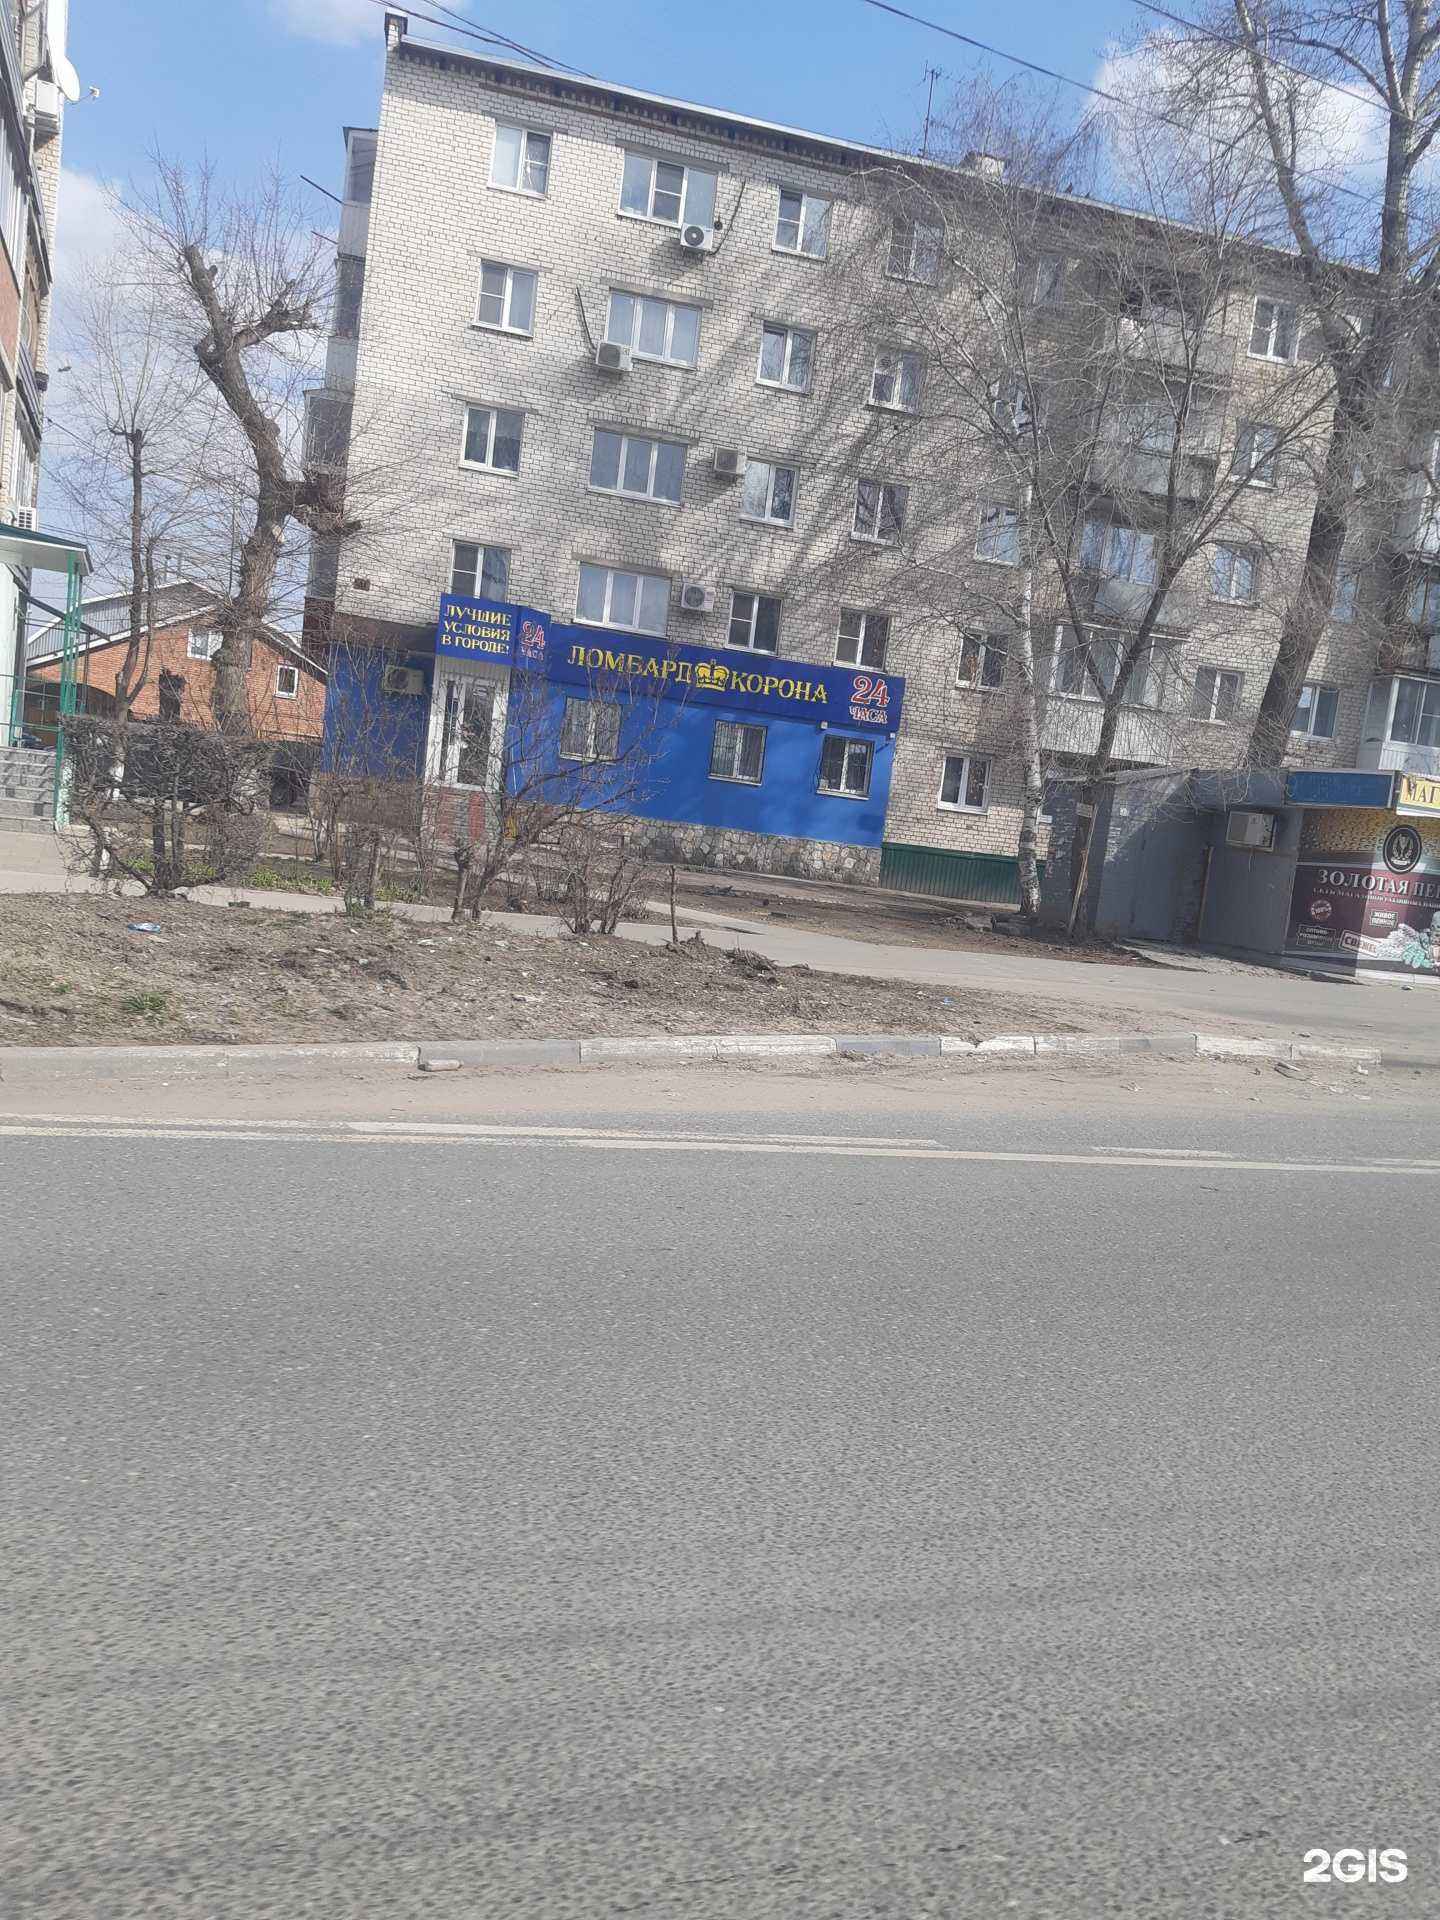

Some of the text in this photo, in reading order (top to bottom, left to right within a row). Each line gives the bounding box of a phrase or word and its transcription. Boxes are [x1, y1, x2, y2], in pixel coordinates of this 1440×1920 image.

[444, 604, 512, 626] ЛУЧШИЕ
[444, 620, 510, 641] УСЛОВИЯ
[522, 620, 545, 649] 24
[441, 634, 512, 656] В ГОРОДЕ!
[567, 645, 828, 704] ЛОМБАРД КОРОНА
[850, 675, 890, 707] 24
[849, 705, 888, 724] ЧАСА
[1319, 869, 1410, 895] ЗОЛОТАЯ
